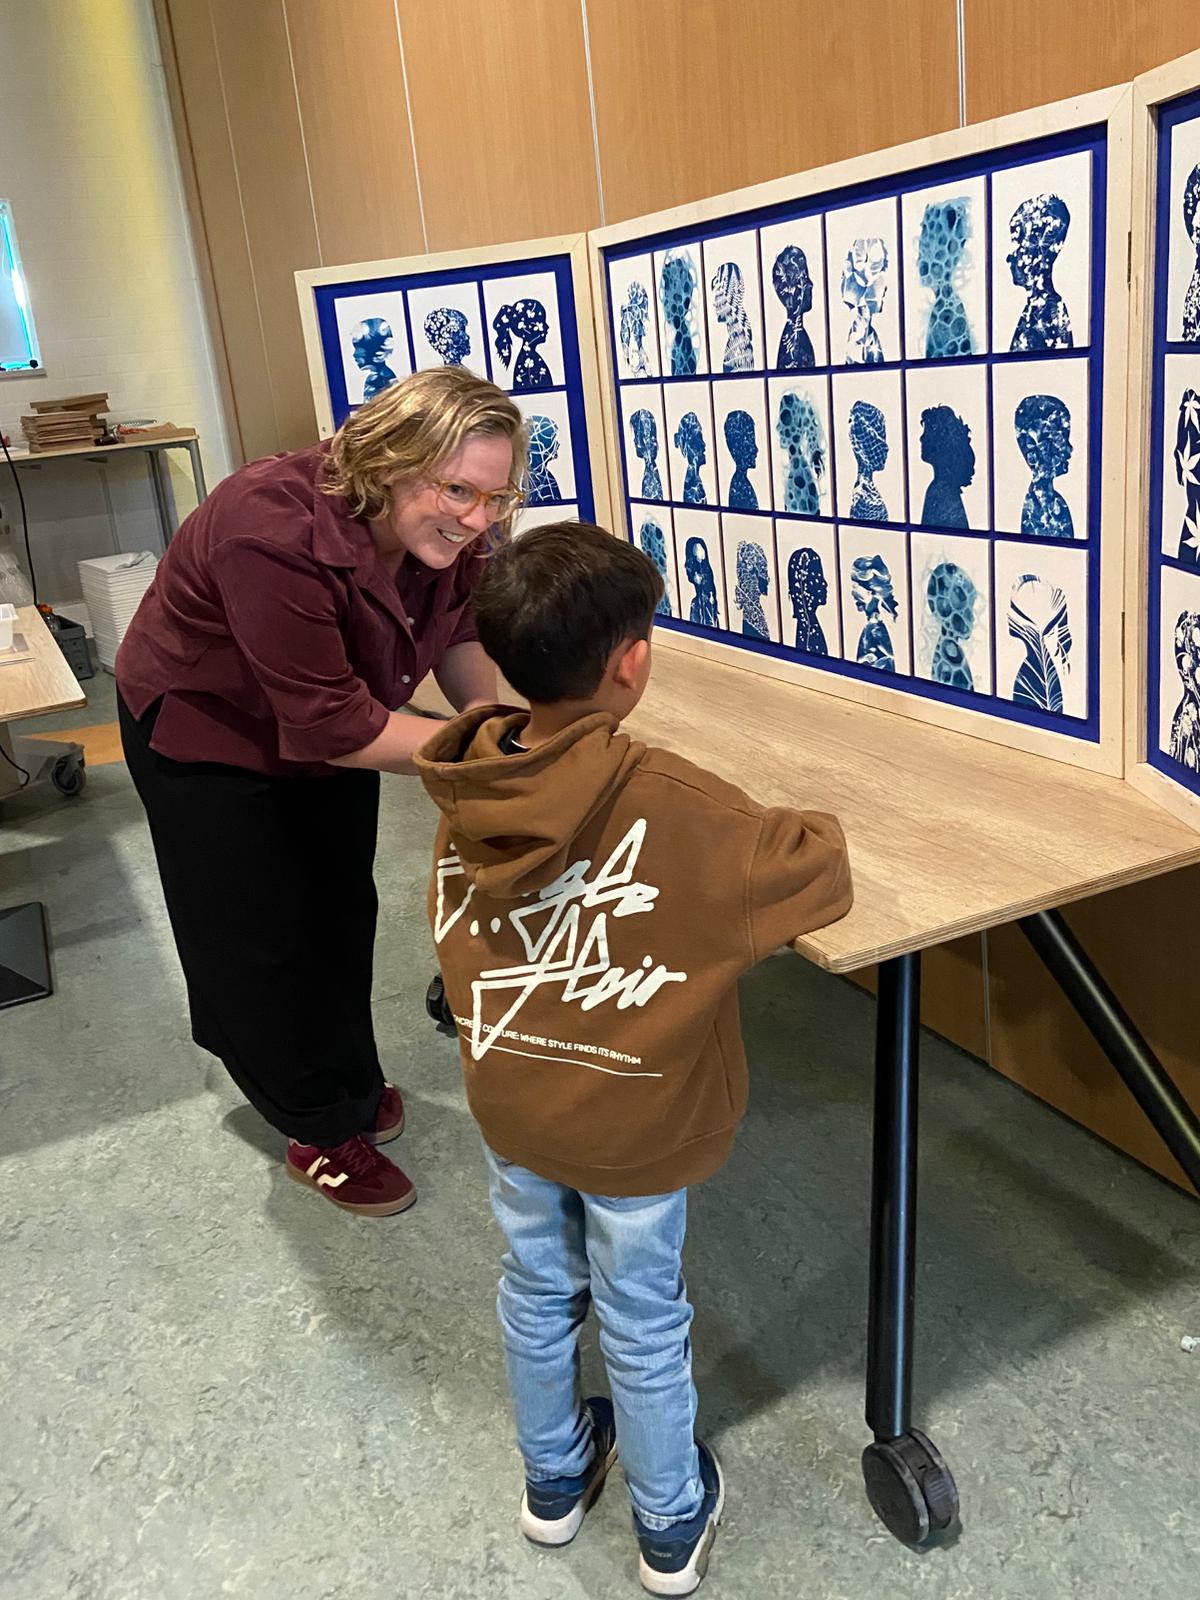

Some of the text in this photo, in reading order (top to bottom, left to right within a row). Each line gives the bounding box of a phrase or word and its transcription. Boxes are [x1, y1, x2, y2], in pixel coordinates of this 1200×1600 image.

[520, 1033, 547, 1047] WHERE
[548, 1039, 573, 1051] STYLE
[574, 1043, 597, 1055] FINDS
[598, 1047, 610, 1057] ITS
[610, 1050, 641, 1065] RHYTHM
